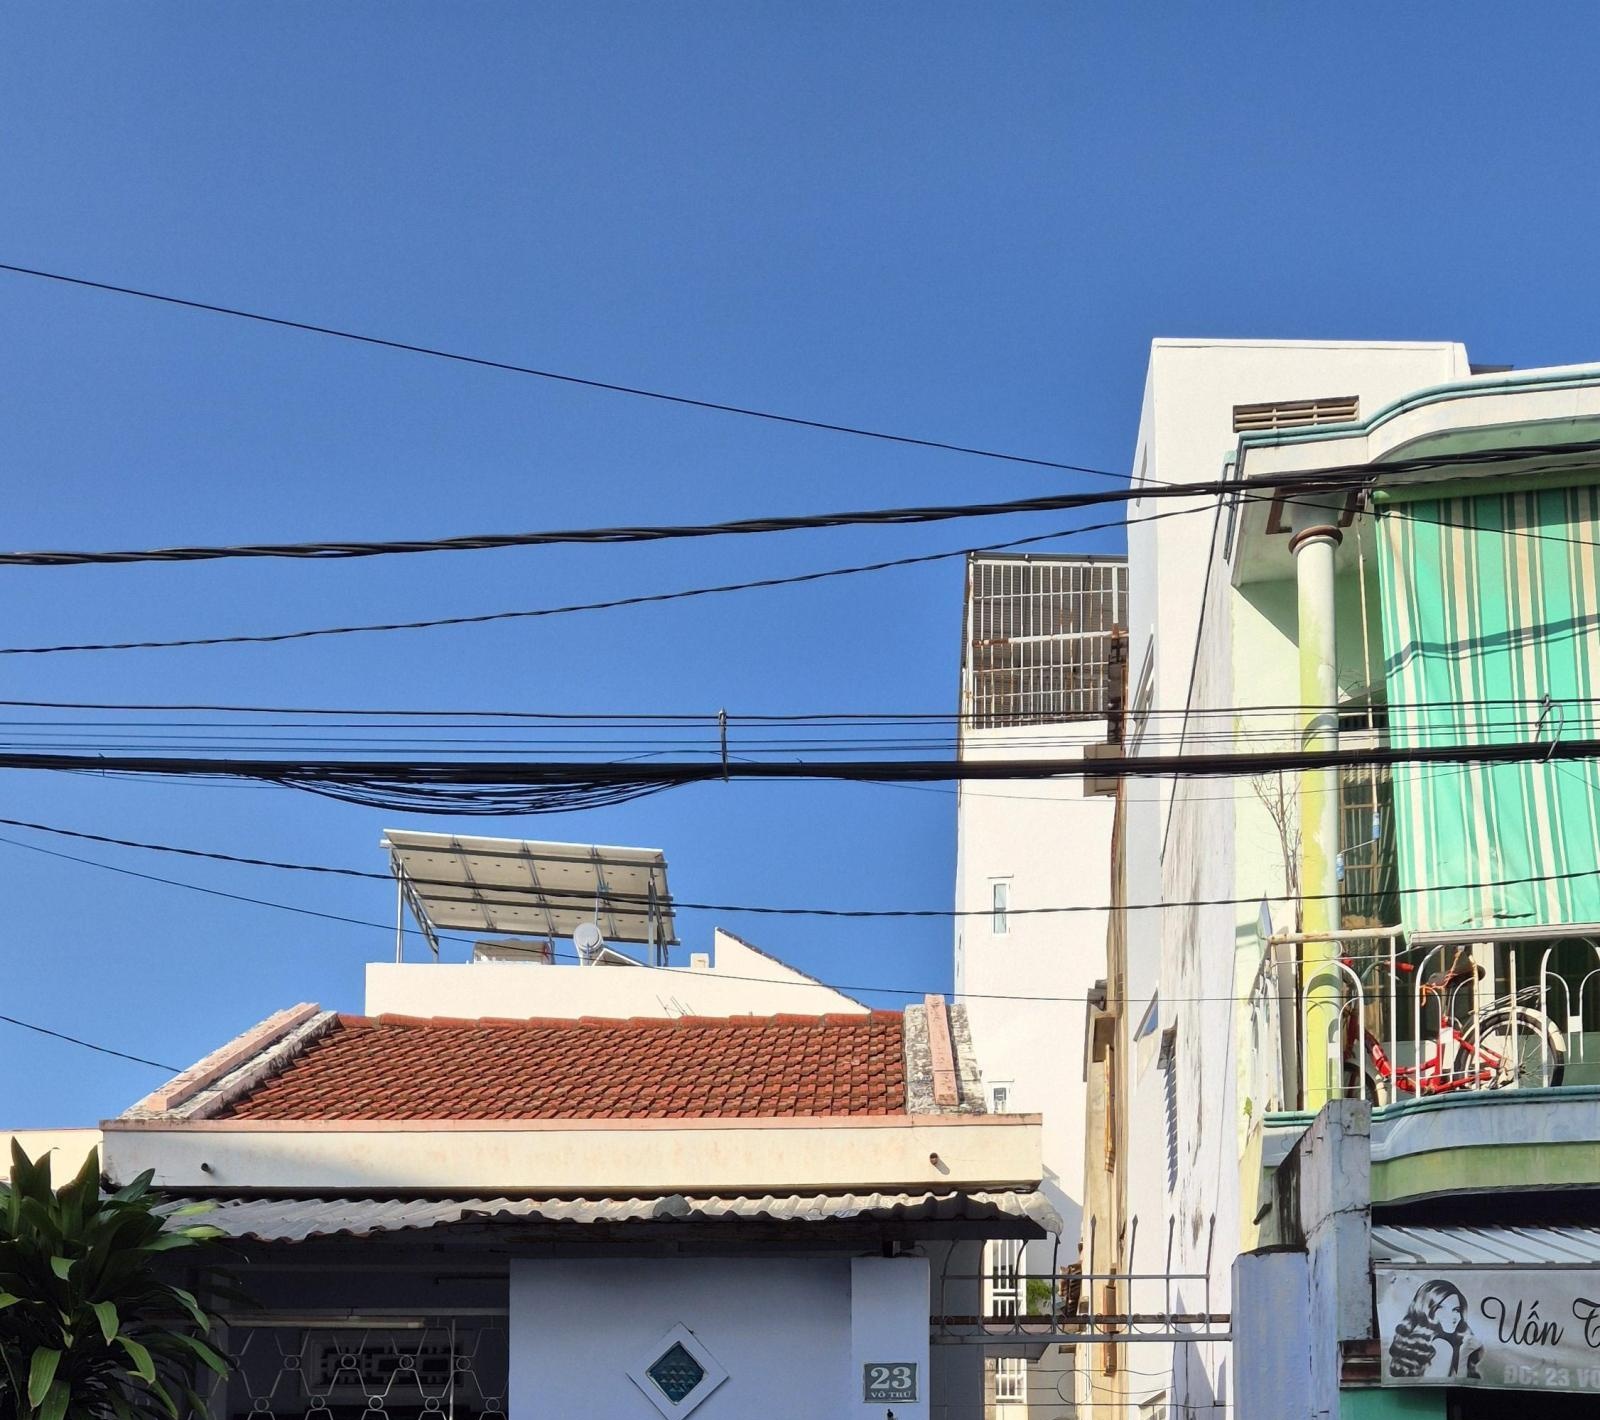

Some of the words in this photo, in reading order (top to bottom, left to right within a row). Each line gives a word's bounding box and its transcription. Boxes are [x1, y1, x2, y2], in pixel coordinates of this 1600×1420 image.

[1480, 1297, 1564, 1347] Uốn
[870, 1366, 912, 1389] 23
[1544, 1366, 1570, 1387] 23
